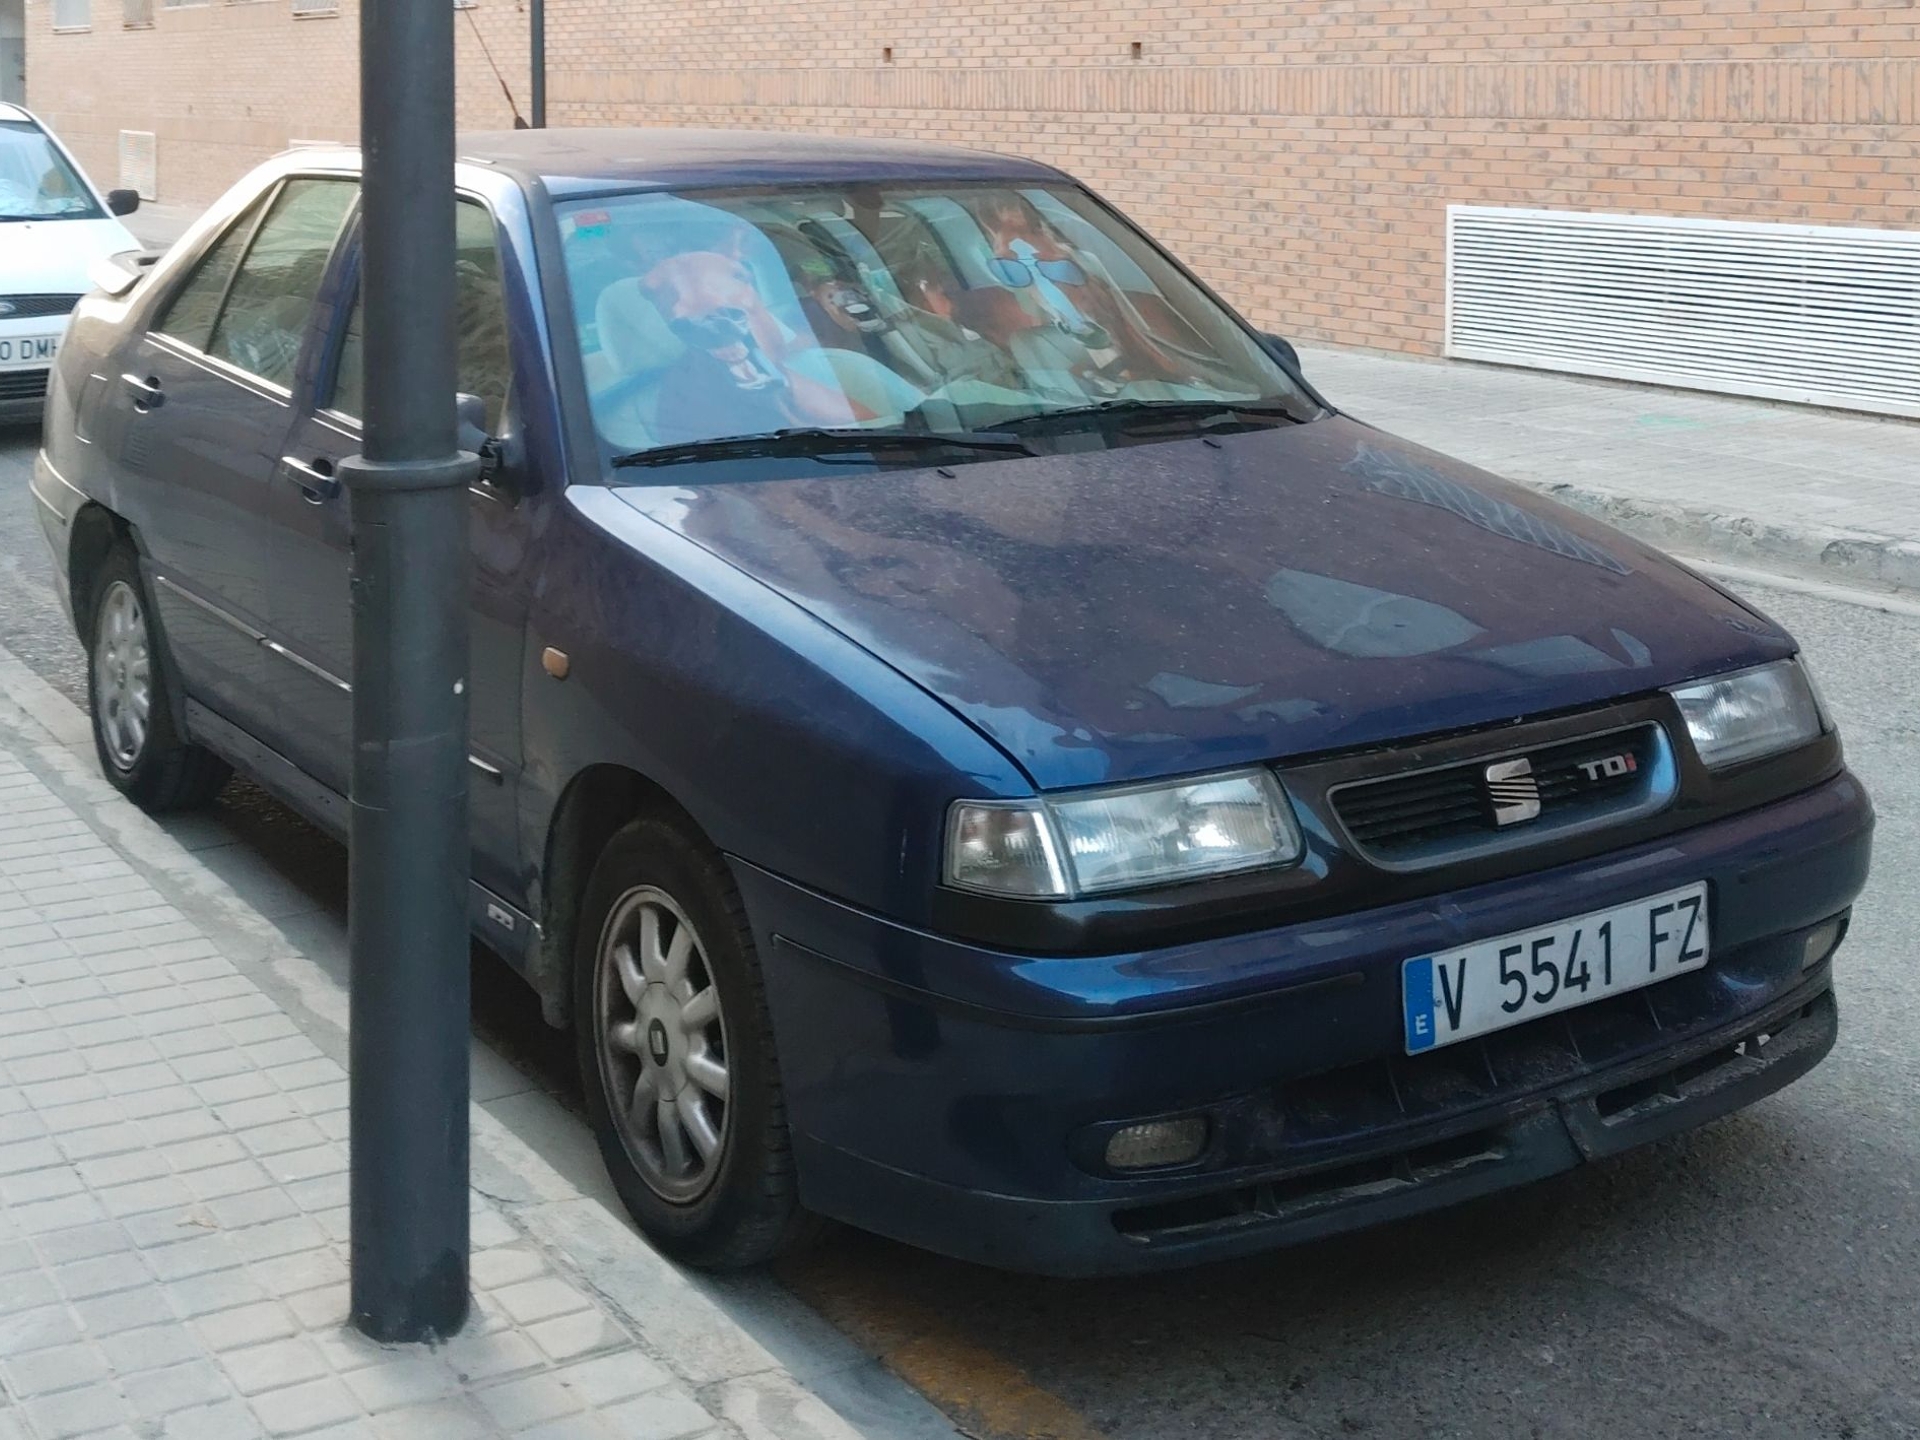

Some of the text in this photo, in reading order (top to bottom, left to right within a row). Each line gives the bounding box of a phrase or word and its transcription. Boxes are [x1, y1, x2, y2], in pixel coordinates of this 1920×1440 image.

[1438, 895, 1704, 1031] V 5541 FZ
[1415, 1014, 1428, 1035] E
